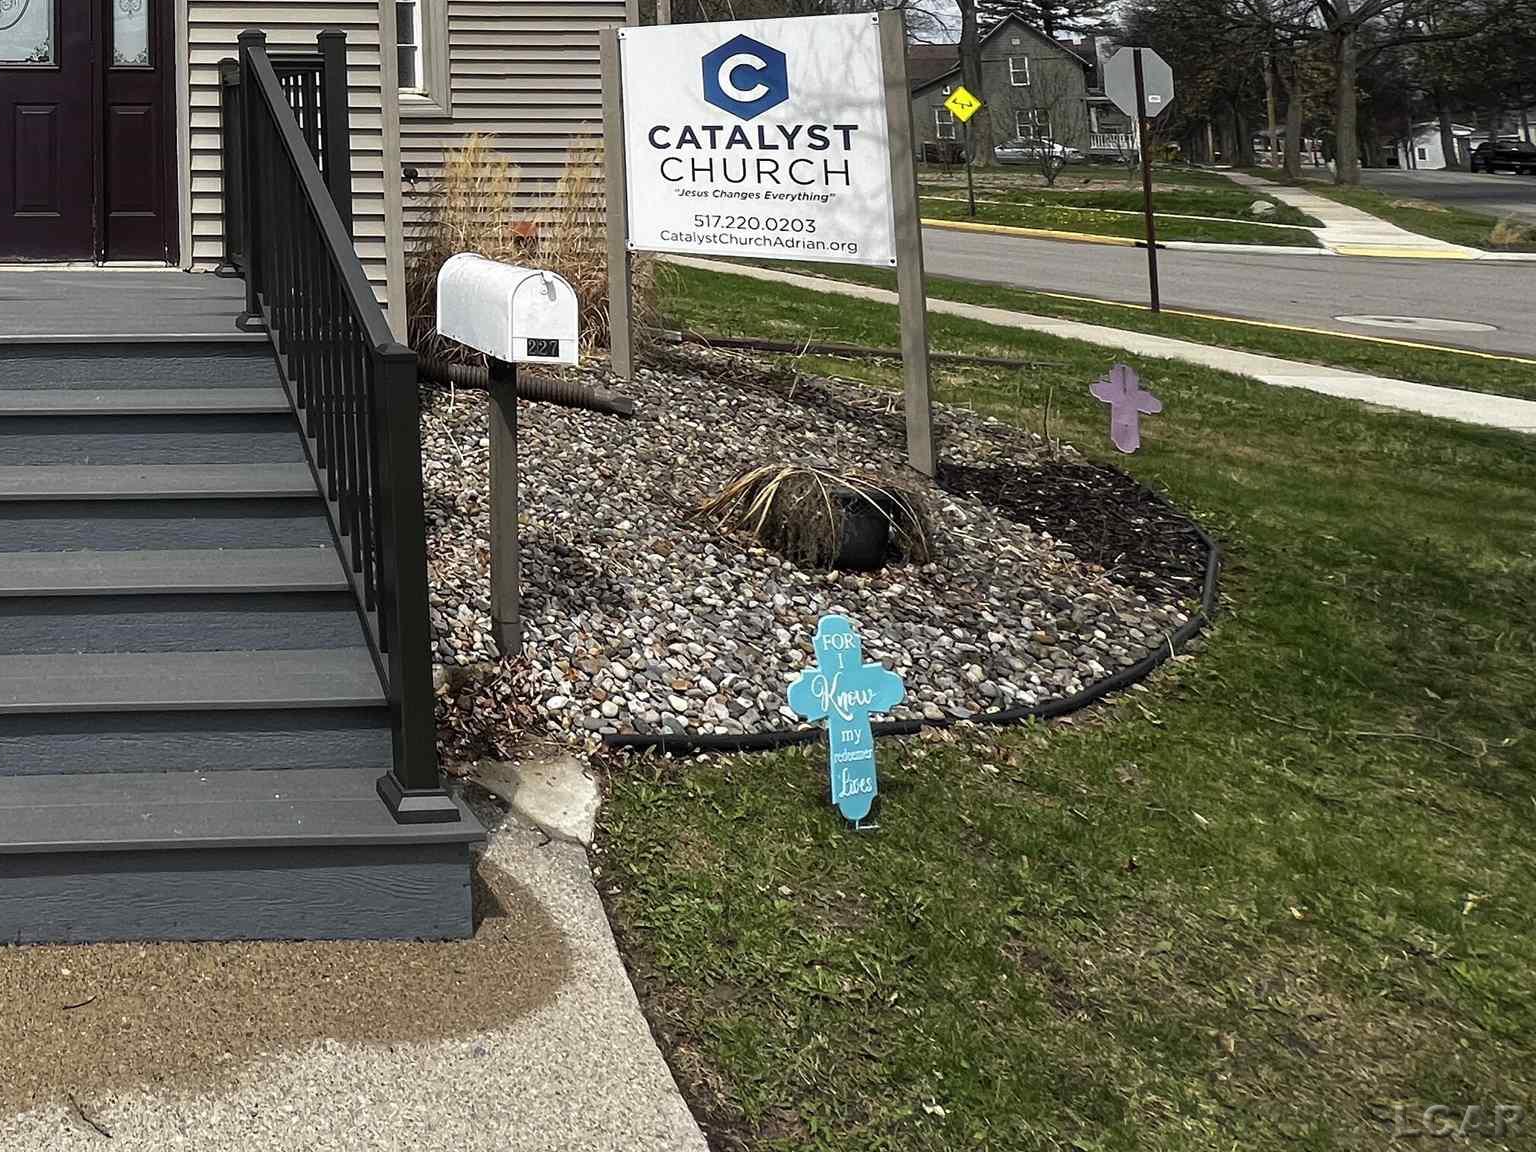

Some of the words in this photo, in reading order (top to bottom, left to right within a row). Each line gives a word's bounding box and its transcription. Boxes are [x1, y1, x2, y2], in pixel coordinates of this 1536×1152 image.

[718, 53, 769, 102] C
[648, 124, 859, 151] CATALYST
[660, 156, 851, 186] CHURCH
[711, 188, 761, 200] Changes
[694, 214, 817, 234] 517.220.0203
[660, 229, 858, 254] CatalystChurchAdrian.org
[528, 339, 558, 356] 227
[822, 633, 856, 650] FOR
[836, 652, 844, 669] I
[811, 672, 877, 721] Know
[841, 729, 862, 745] my
[839, 768, 873, 798] Lives
